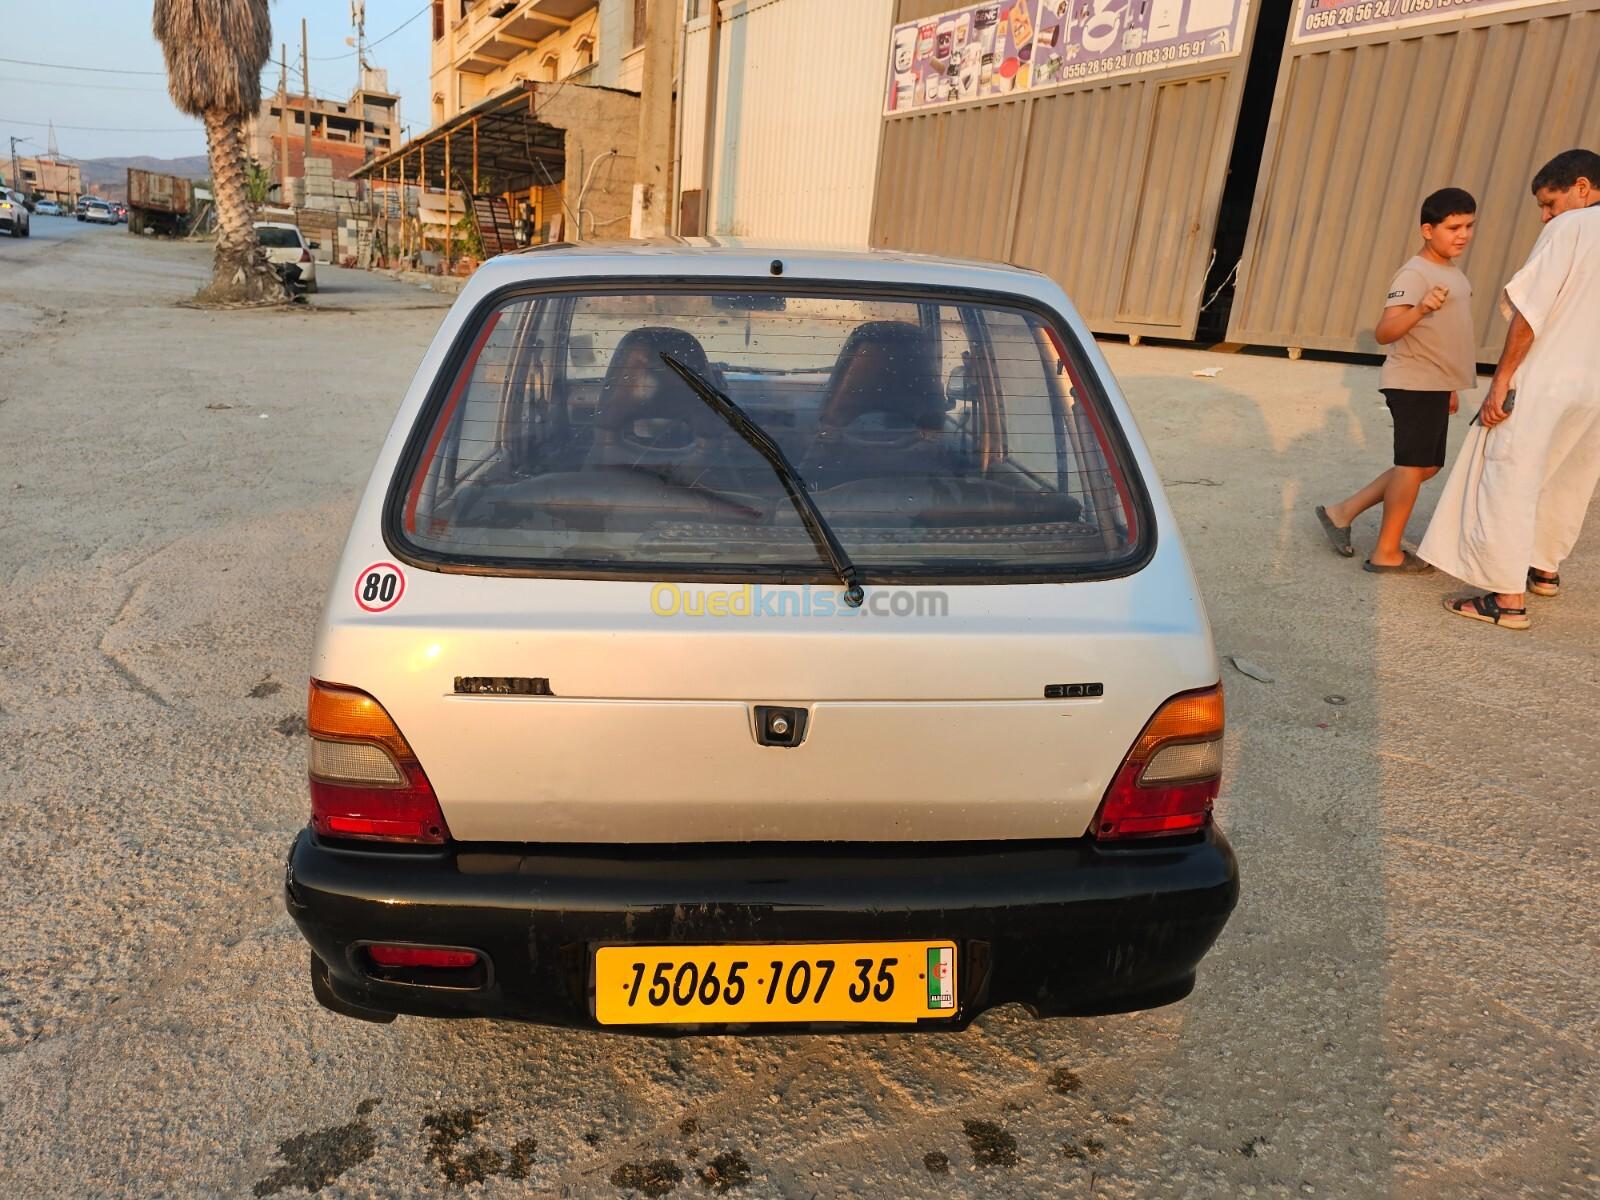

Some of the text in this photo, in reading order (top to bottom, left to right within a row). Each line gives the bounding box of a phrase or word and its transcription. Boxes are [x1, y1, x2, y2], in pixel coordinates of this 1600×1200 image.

[1305, 9, 1336, 30] 0556
[1337, 6, 1355, 25] 28
[1355, 3, 1373, 22] 56
[1373, 0, 1391, 18] 24
[1062, 62, 1087, 79] 0556
[1087, 60, 1100, 74] 28
[1101, 58, 1114, 72] 56
[1115, 55, 1128, 70] 24
[1135, 50, 1160, 66] 0783
[1162, 46, 1176, 61] 30
[1178, 43, 1191, 58] 15
[1191, 40, 1206, 56] 91
[362, 572, 397, 603] 80
[627, 957, 899, 1007] 15065 107 35
